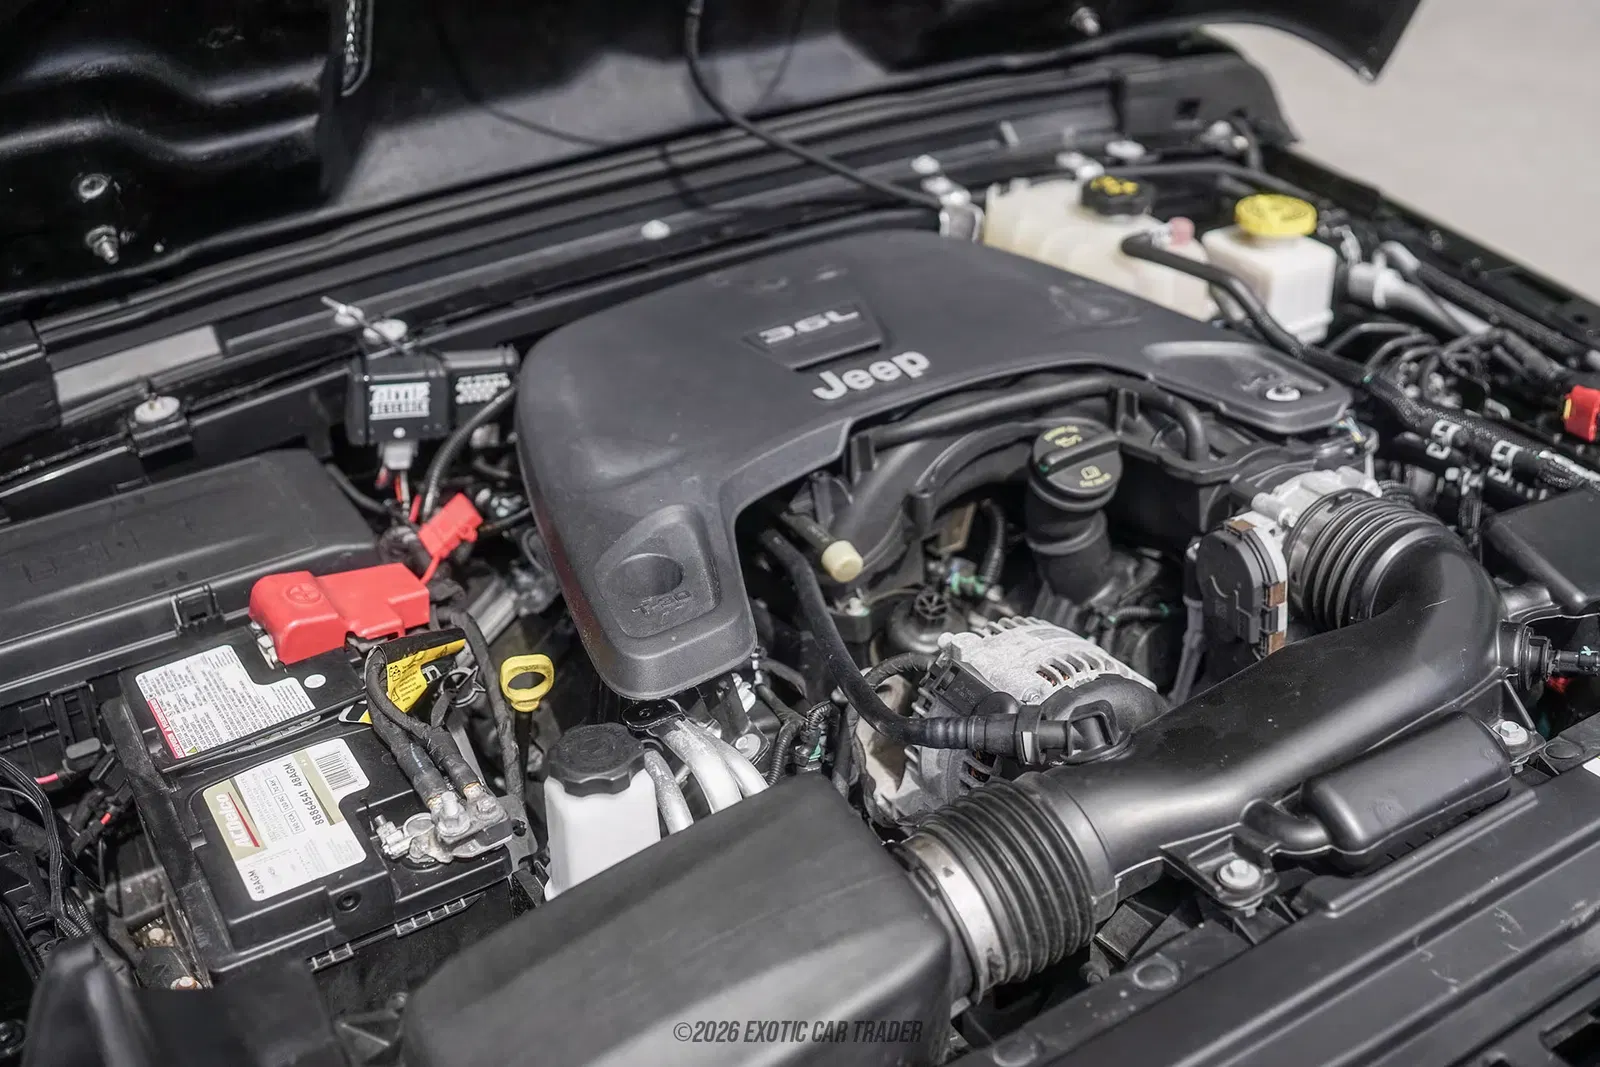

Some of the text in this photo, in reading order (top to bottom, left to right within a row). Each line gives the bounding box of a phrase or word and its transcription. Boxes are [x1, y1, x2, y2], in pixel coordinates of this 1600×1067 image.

[812, 351, 930, 400] Jeep
[283, 762, 303, 787] 48AGM
[298, 789, 325, 826] 88864541
[248, 870, 265, 895] 48AGM
